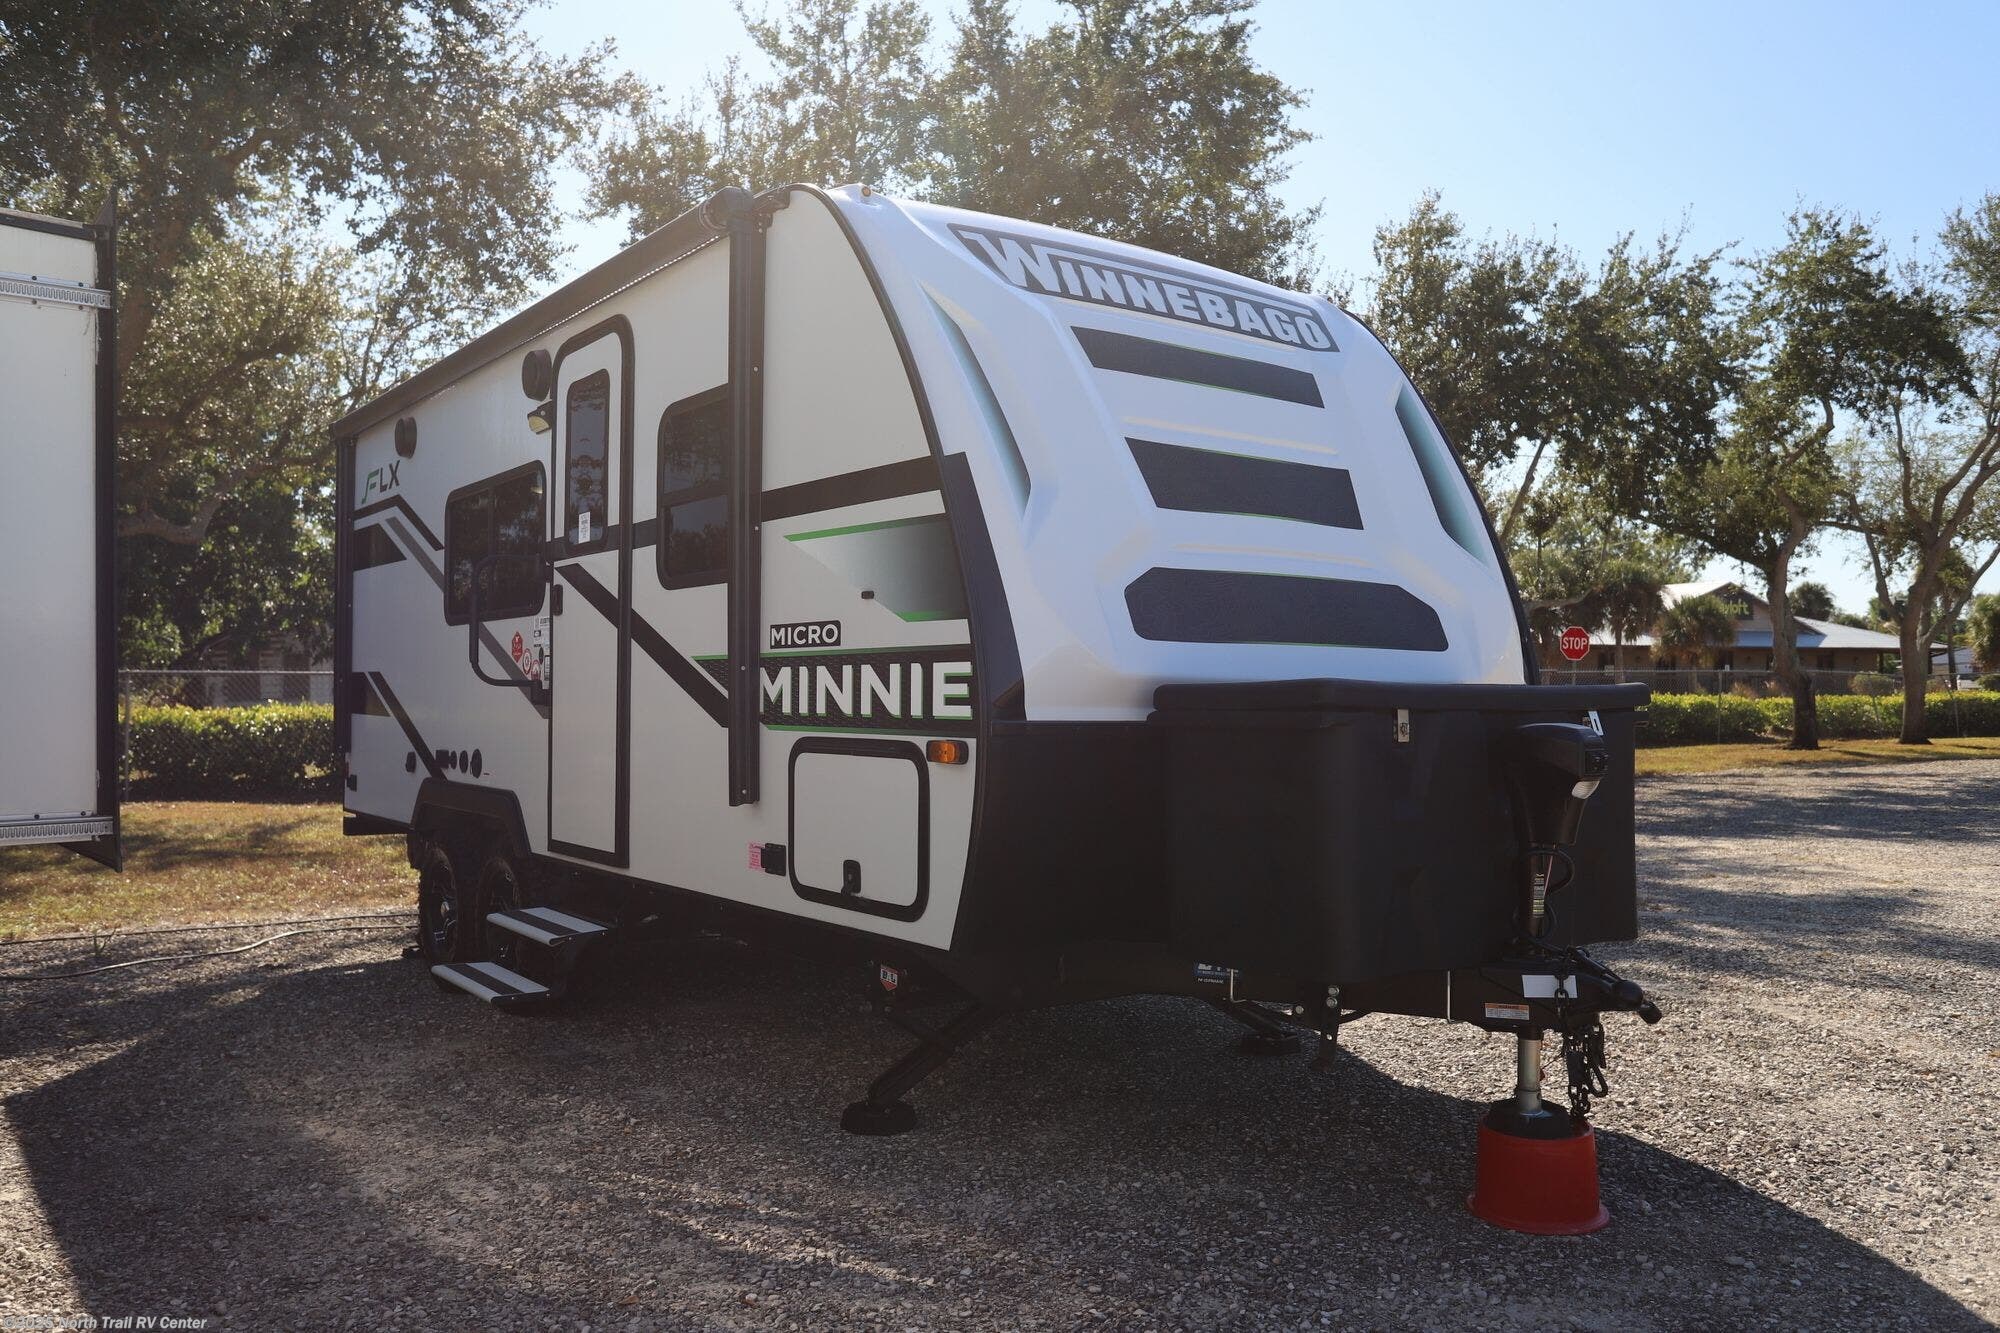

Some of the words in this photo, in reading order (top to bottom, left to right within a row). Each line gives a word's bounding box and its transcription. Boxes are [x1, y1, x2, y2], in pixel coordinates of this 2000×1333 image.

[960, 230, 1331, 349] WINNEBAGO
[361, 459, 400, 504] FLX
[771, 623, 839, 646] MICRO
[1562, 637, 1588, 650] STOP
[760, 661, 973, 720] MINNIE
